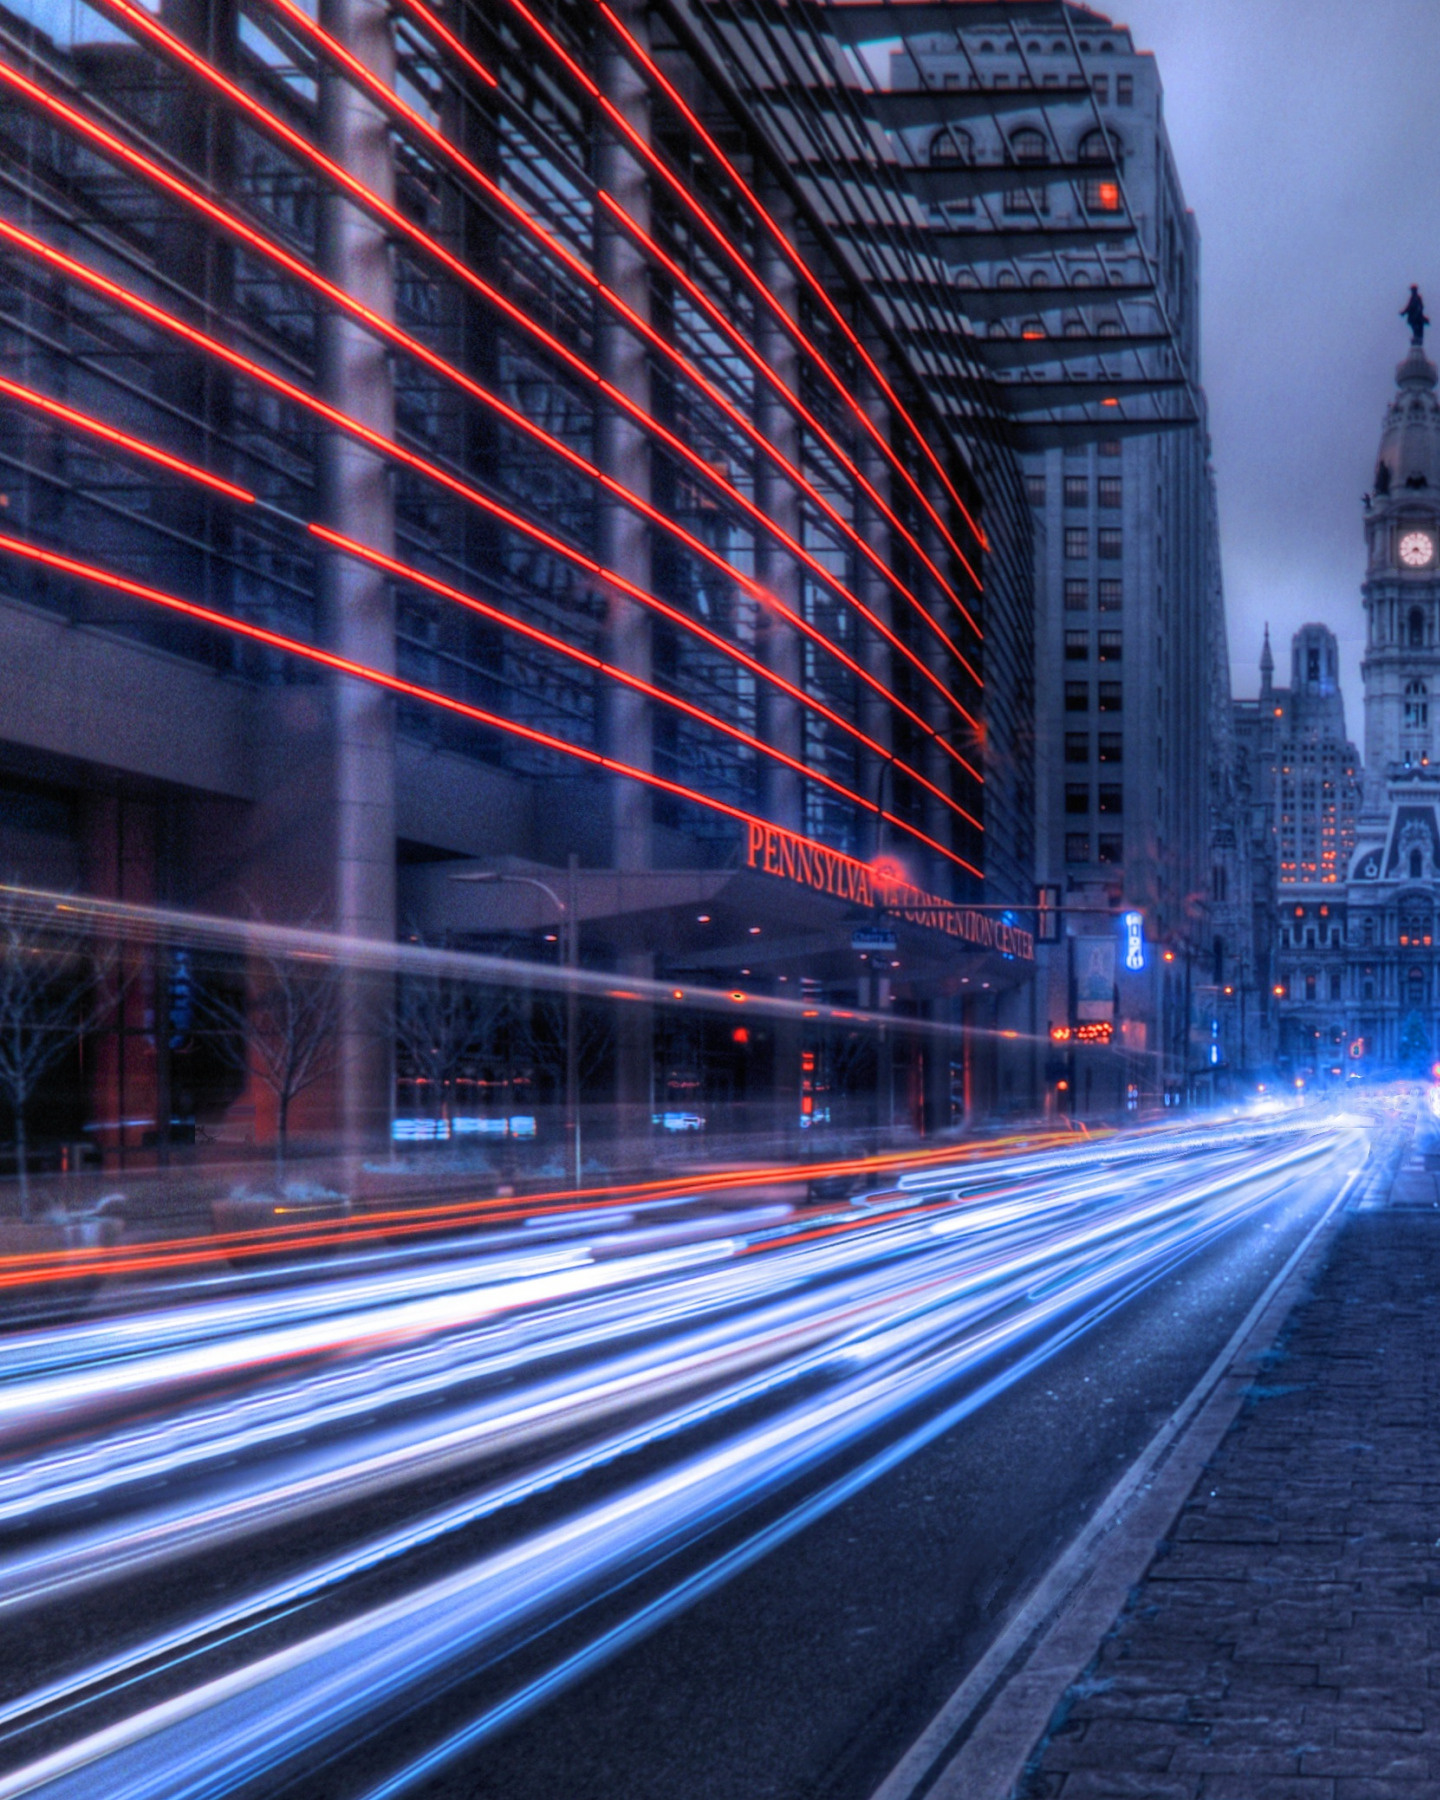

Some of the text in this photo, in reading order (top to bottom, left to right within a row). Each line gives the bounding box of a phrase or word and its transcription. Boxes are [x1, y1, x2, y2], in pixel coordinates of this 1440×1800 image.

[747, 821, 1034, 960] PENNSYLVAIA CONVENTION CENTER
